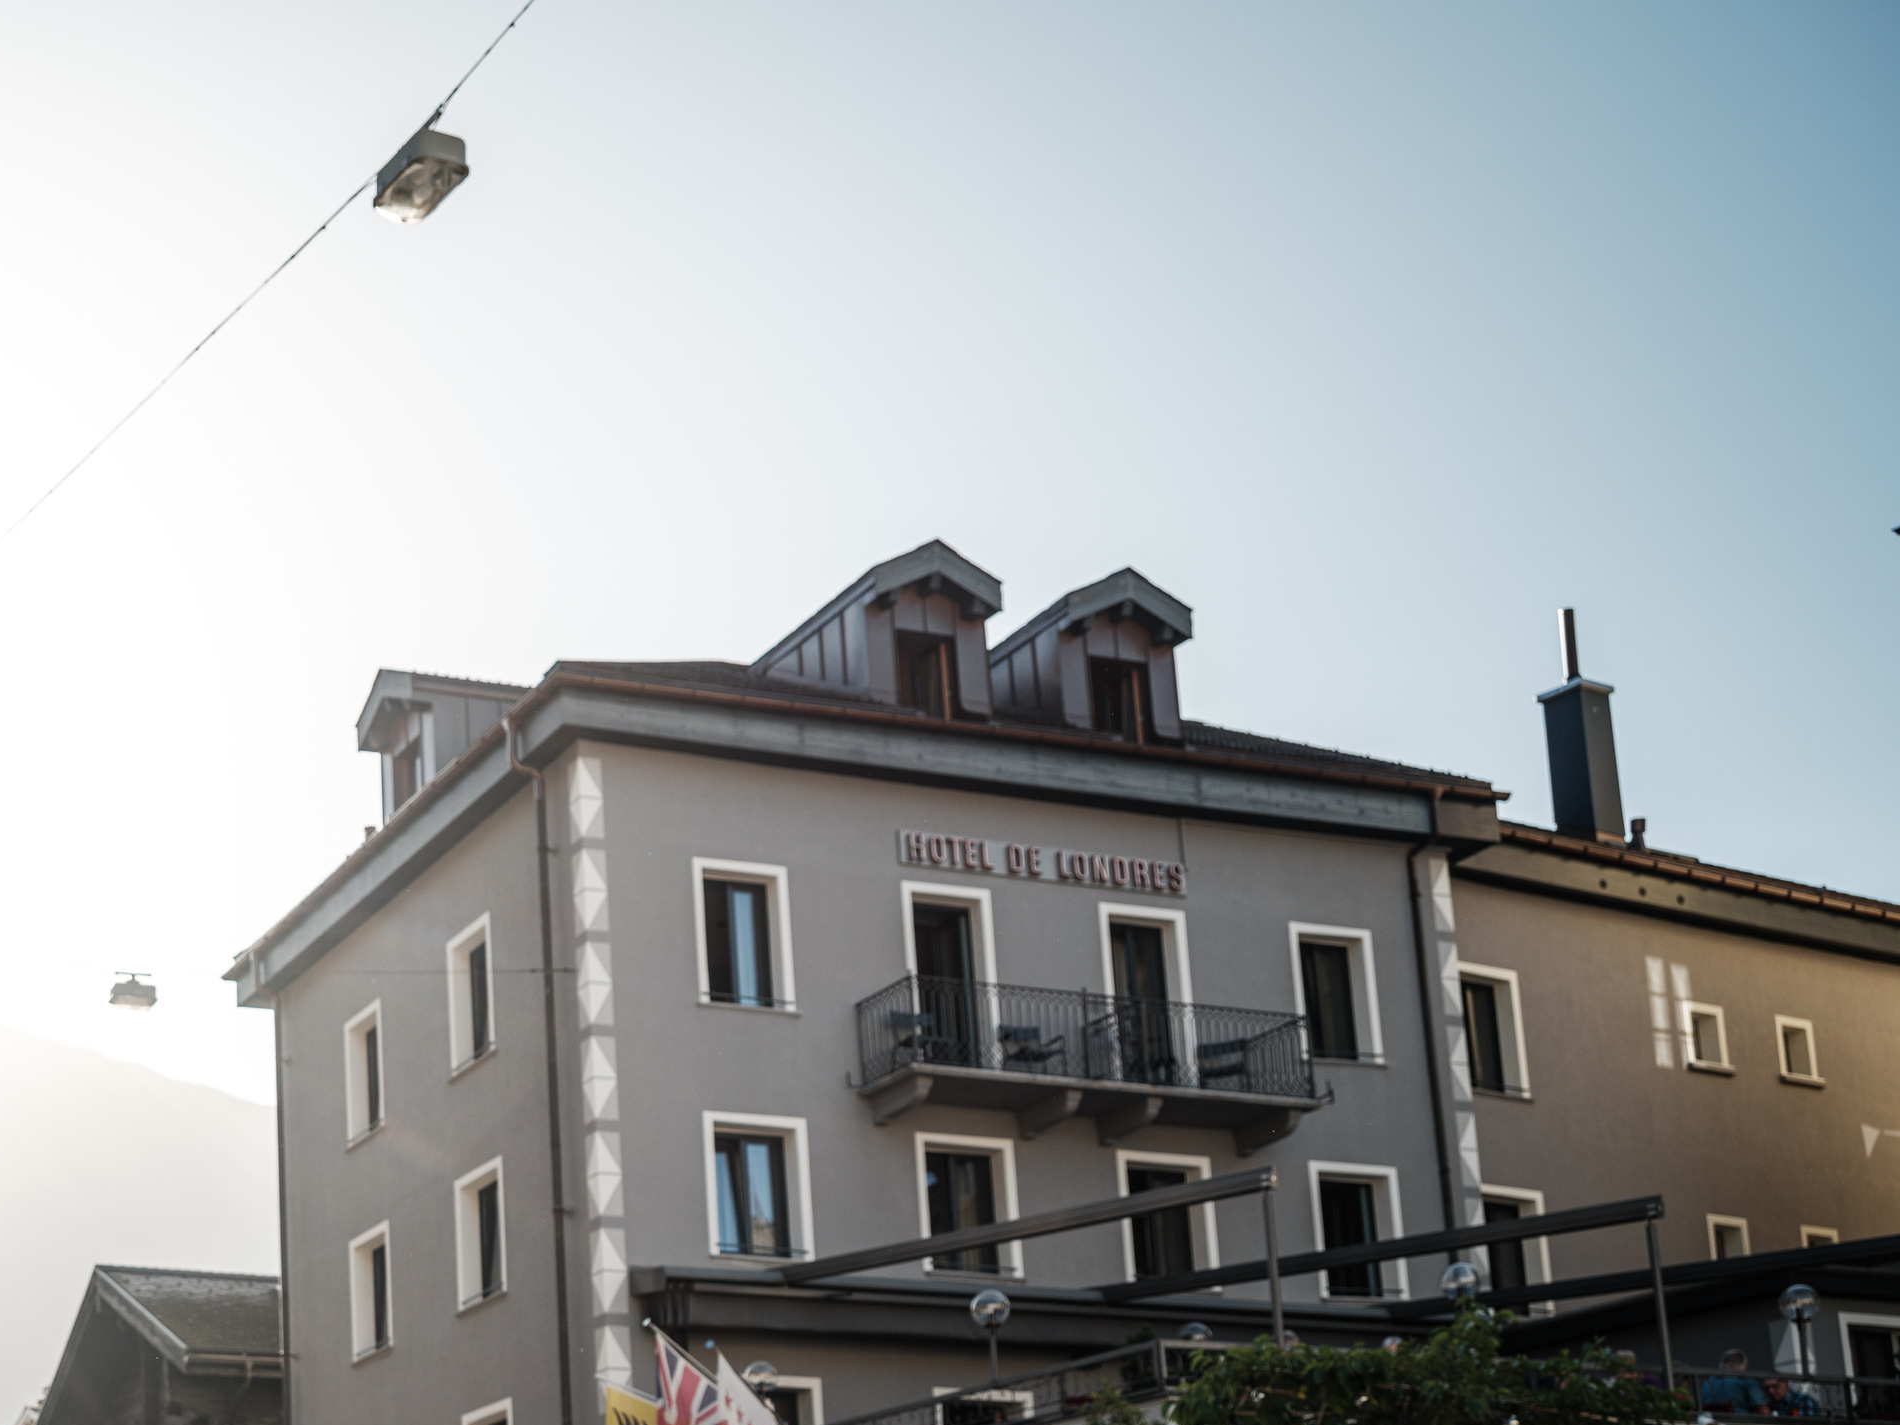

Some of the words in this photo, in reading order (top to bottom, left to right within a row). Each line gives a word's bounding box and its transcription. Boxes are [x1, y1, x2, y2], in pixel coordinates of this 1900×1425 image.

[907, 831, 995, 870] HOTEL
[1008, 843, 1041, 875] DE
[1058, 849, 1186, 891] LONDRES
